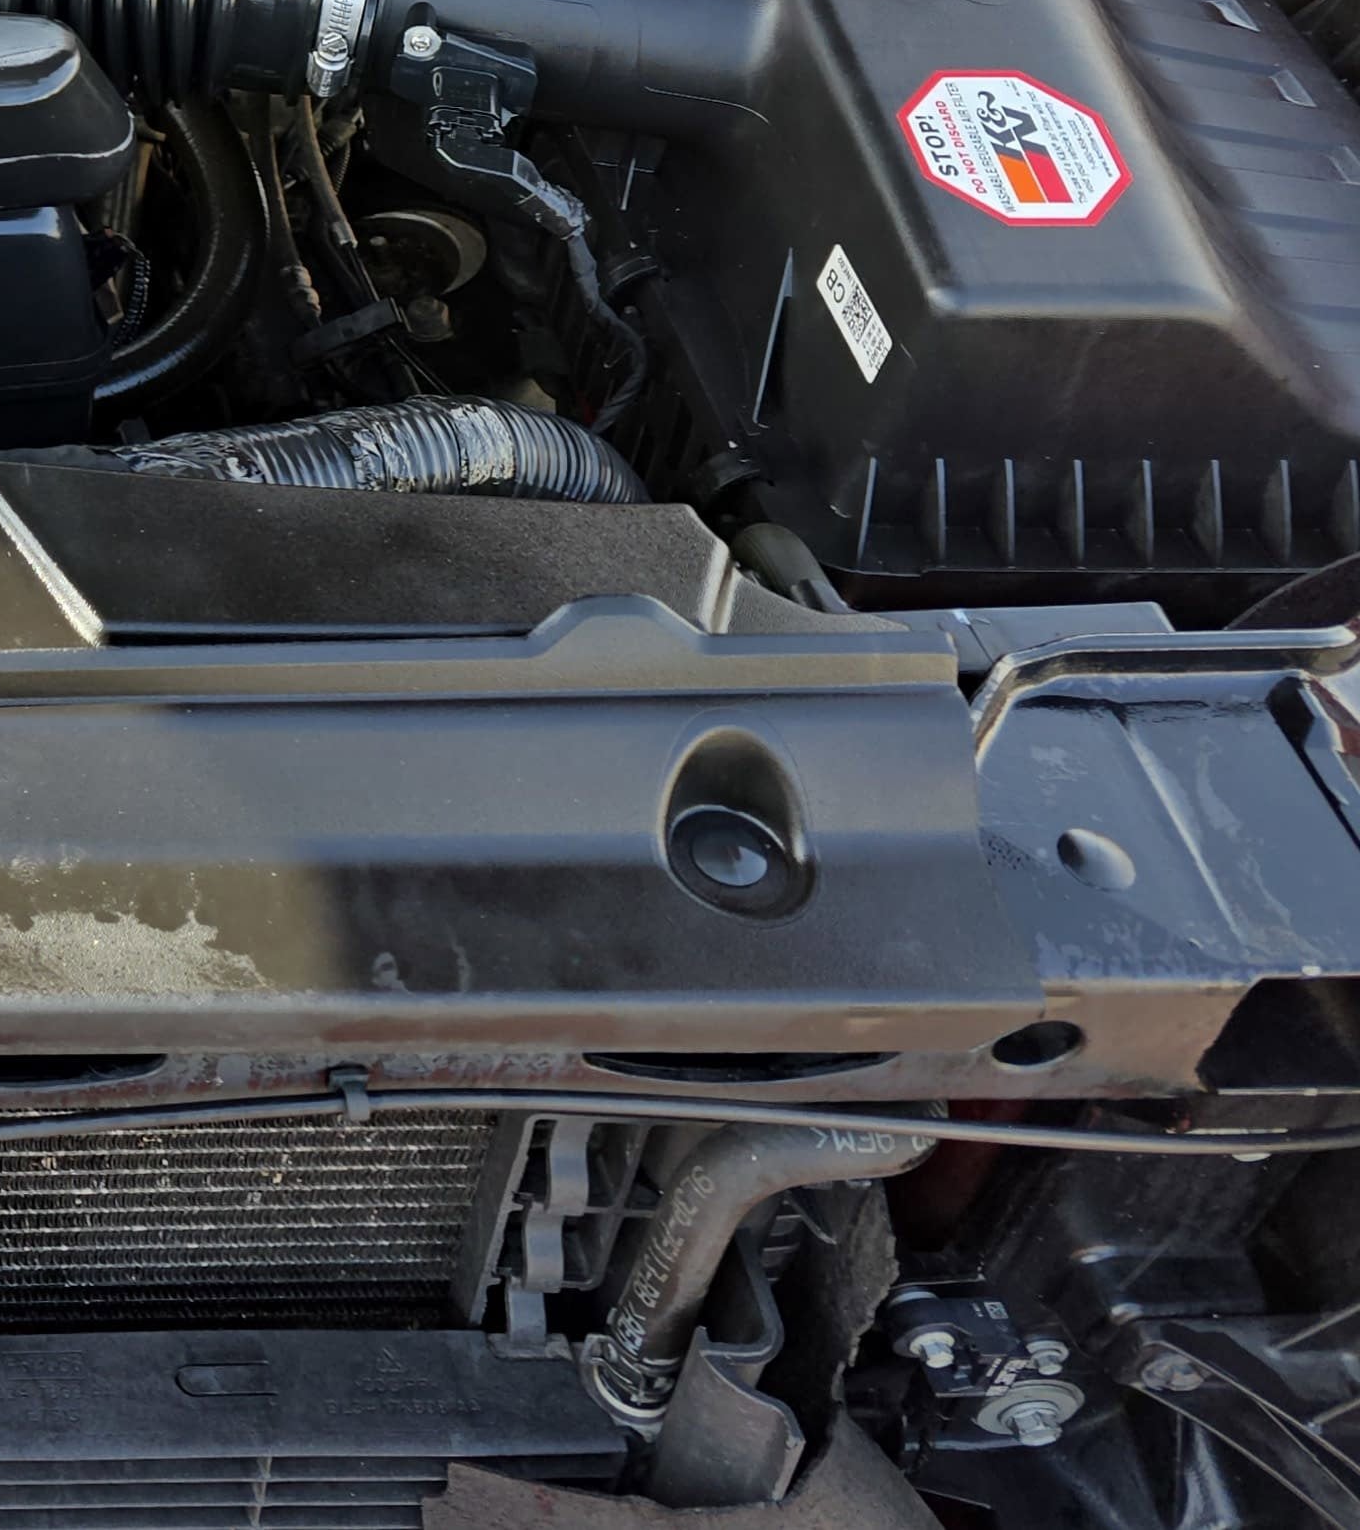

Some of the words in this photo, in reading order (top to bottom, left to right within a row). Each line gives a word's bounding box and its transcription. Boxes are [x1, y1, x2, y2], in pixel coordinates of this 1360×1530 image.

[943, 81, 967, 107] FILTER
[934, 100, 966, 148] DISCARD
[1038, 115, 1054, 131] filter
[1042, 101, 1063, 130] warranty
[914, 114, 960, 176] STOP!
[957, 151, 979, 175] NOT
[1072, 161, 1089, 176] your
[970, 178, 987, 194] DO
[1074, 189, 1088, 203] The
[826, 268, 846, 304] CB
